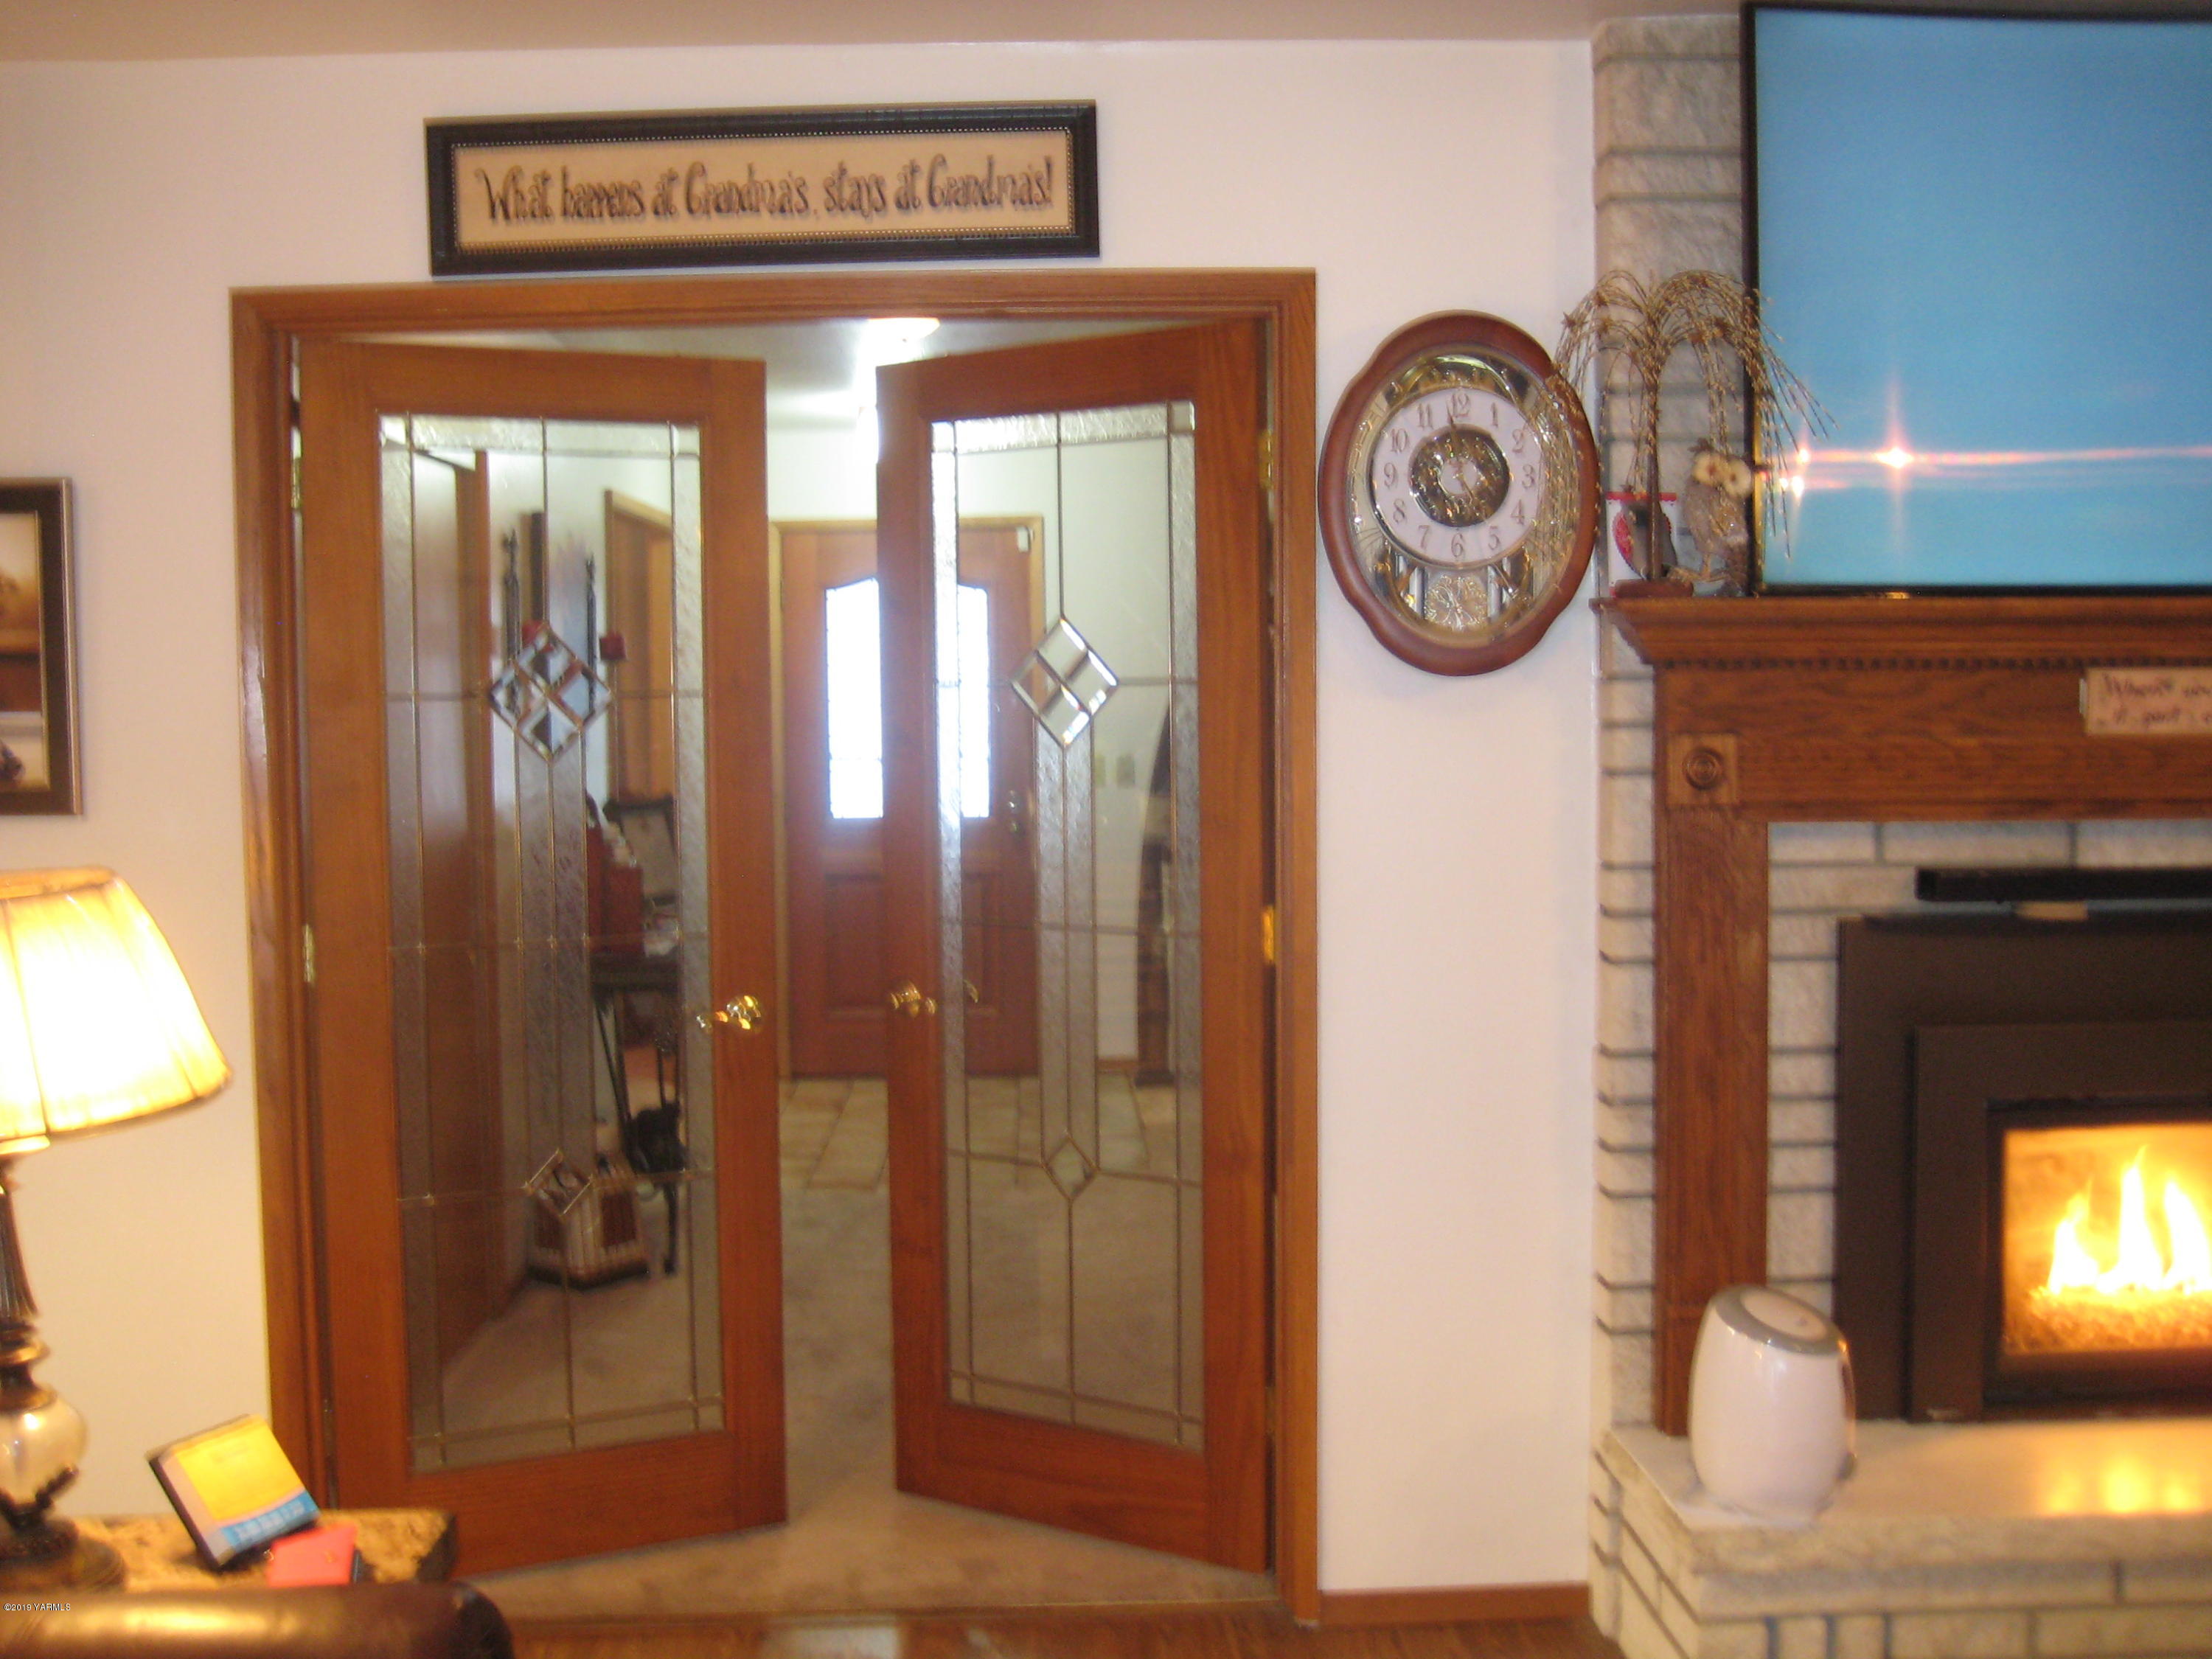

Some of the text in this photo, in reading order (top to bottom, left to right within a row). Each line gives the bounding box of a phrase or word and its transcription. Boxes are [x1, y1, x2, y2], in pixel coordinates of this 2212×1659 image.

[474, 164, 554, 223] What
[651, 167, 679, 217] at
[822, 161, 886, 218] stays
[894, 159, 922, 210] at
[1417, 403, 1433, 428] 11
[1451, 394, 1470, 418] 12
[1490, 402, 1499, 428] 1
[1390, 428, 1408, 453] 10
[1512, 428, 1524, 453] 2
[1383, 462, 1397, 490] 9
[1521, 463, 1535, 490] 3
[1392, 498, 1406, 525] 8
[1510, 498, 1524, 526] 4
[1417, 524, 1430, 550] 7
[1450, 532, 1465, 558] 6
[1488, 524, 1501, 551] 5
